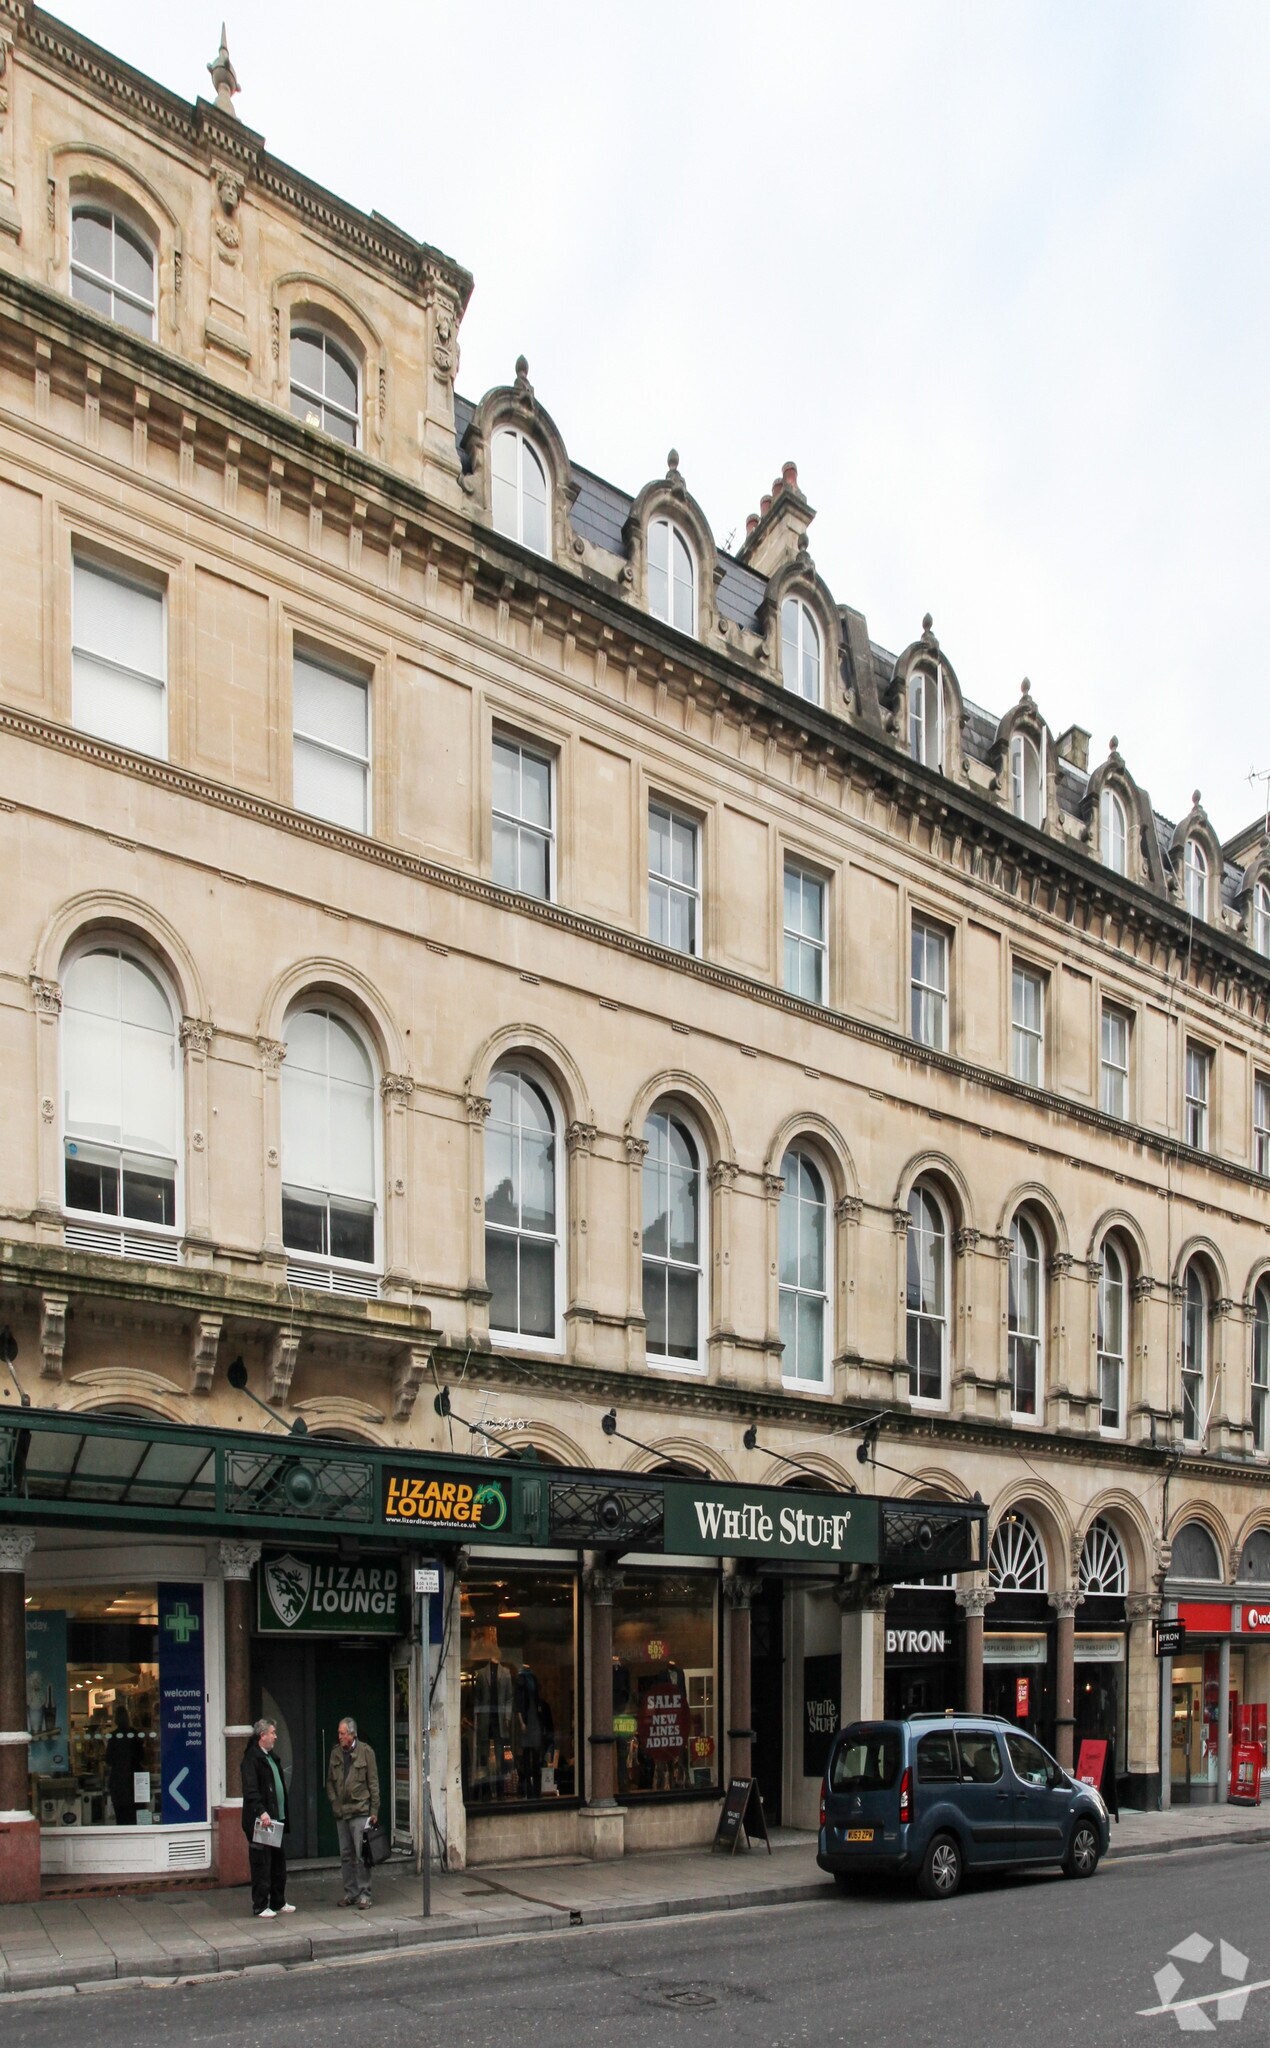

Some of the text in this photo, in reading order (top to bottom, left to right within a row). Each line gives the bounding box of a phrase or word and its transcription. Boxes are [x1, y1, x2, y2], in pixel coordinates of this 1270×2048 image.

[388, 1477, 473, 1503] LIZARD
[386, 1496, 482, 1521] LOUNGE
[385, 1517, 476, 1528] www.lizardloungebristol.co.uk
[314, 1566, 398, 1591] LIZARD
[312, 1589, 396, 1614] LOUNGE
[886, 1630, 945, 1652] BYRON
[1159, 1633, 1180, 1642] BYRON
[164, 1689, 201, 1697] welcome
[647, 1695, 681, 1709] SALE
[652, 1714, 677, 1725] NEW
[649, 1725, 680, 1737] LINES
[646, 1737, 683, 1748] ADDED
